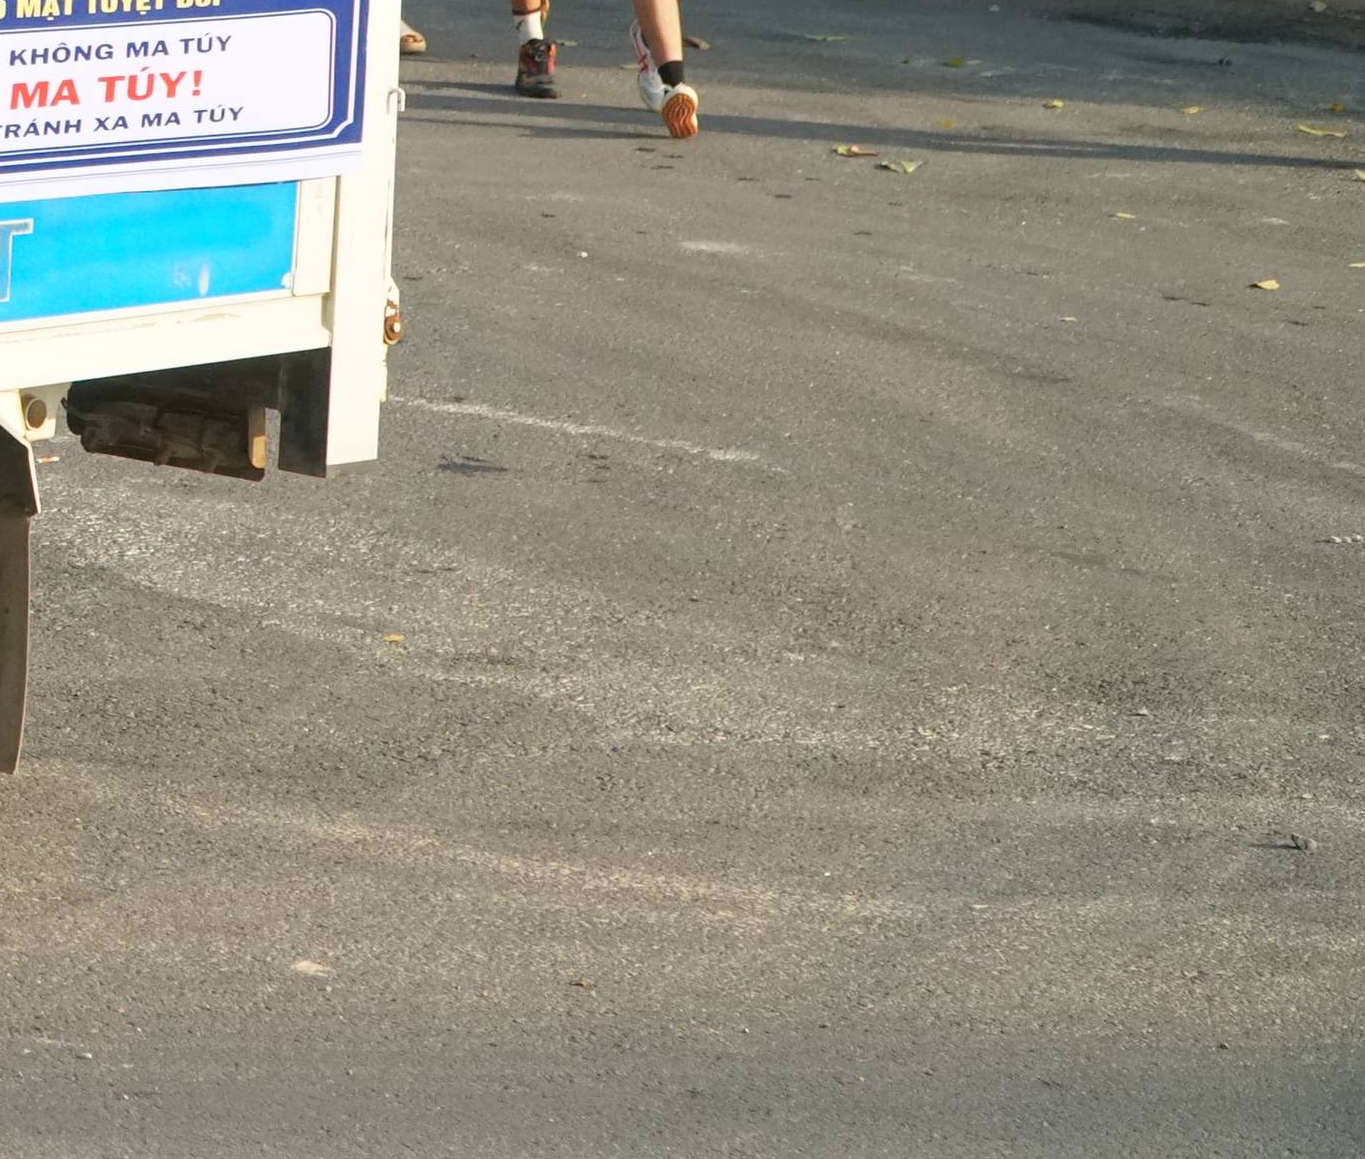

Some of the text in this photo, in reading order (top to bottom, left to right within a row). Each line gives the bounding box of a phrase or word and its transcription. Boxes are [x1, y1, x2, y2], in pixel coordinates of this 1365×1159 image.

[10, 43, 113, 66] KHÔNG
[127, 41, 168, 57] MA
[180, 31, 230, 53] TÚY
[10, 79, 79, 109] MA
[100, 70, 202, 102] TÚY!
[95, 116, 128, 131] XA
[142, 112, 180, 127] MA
[194, 108, 242, 123] TÚY
